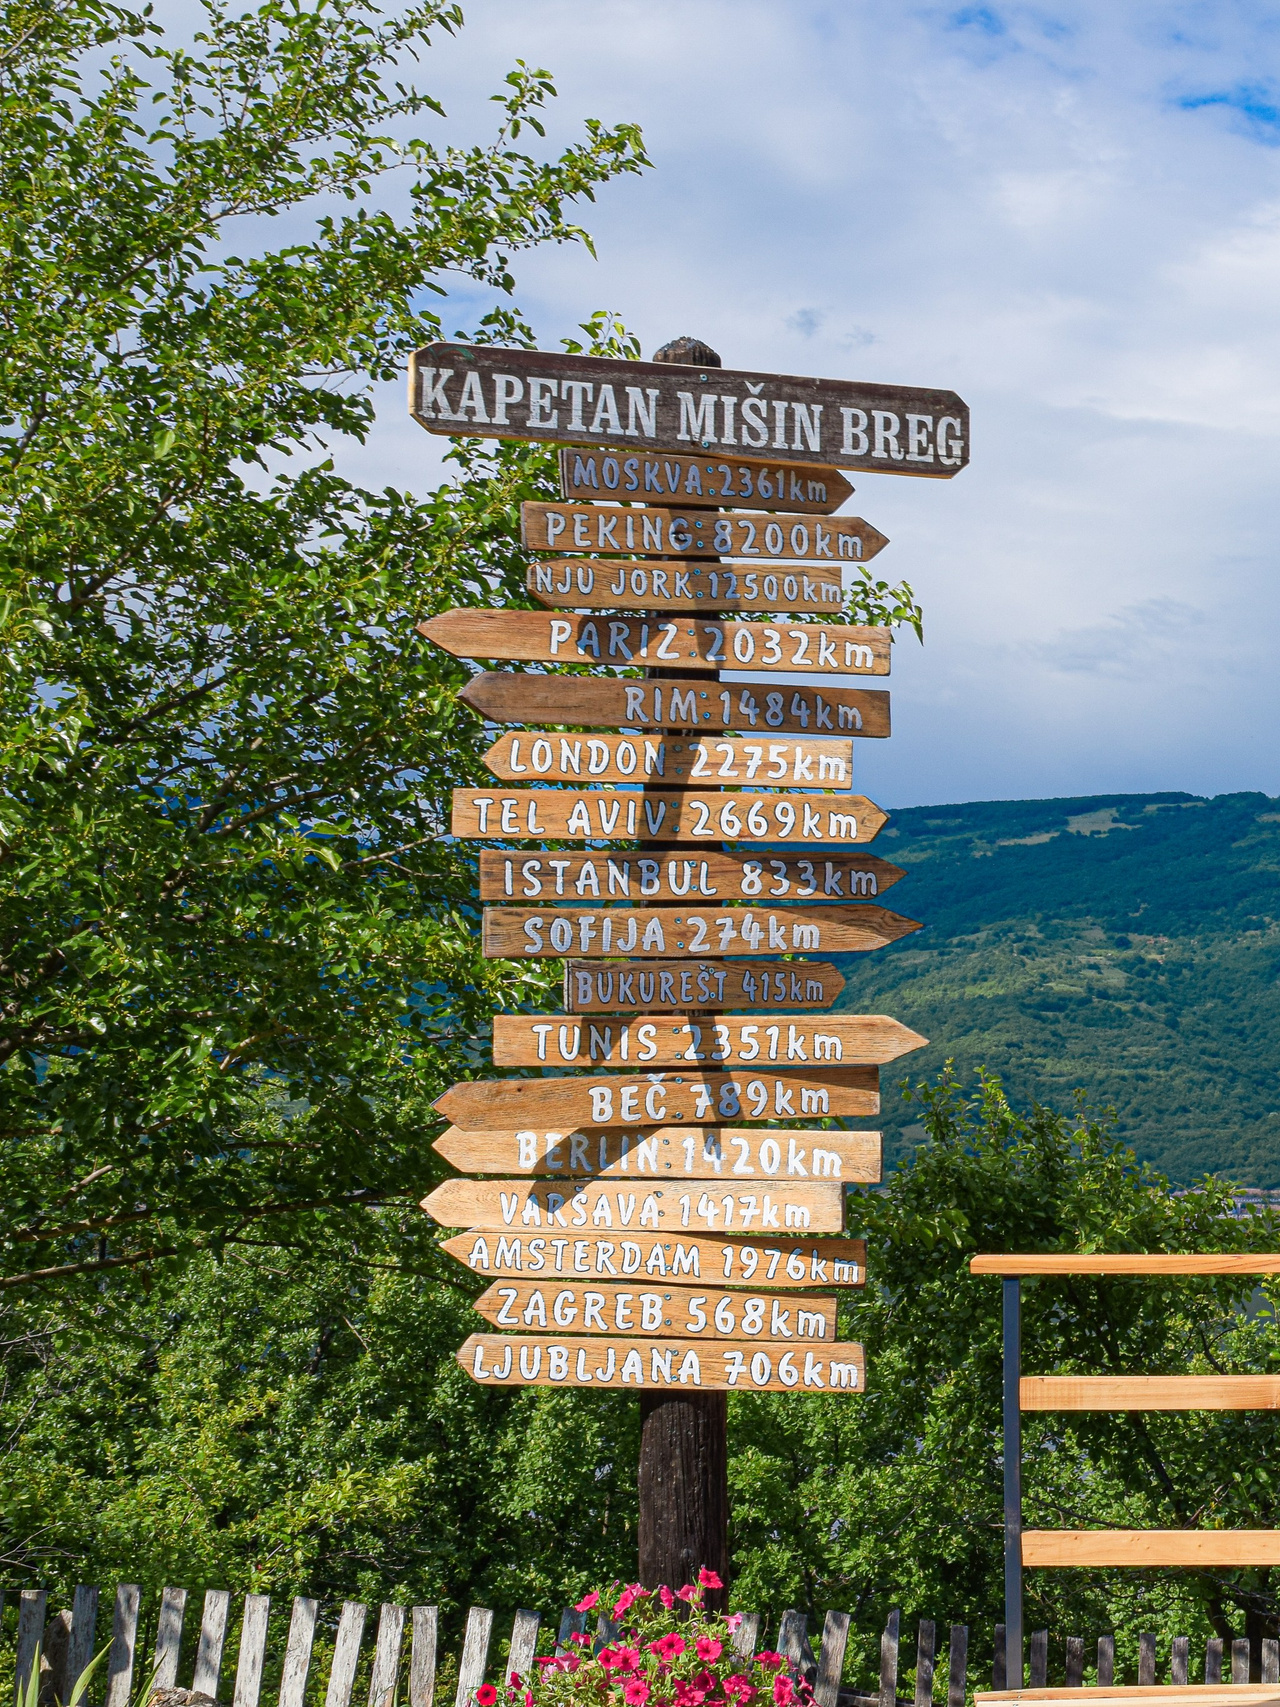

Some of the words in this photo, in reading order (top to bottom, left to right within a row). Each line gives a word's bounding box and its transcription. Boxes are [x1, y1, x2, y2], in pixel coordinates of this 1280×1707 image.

[418, 366, 660, 437] KAPETAN
[676, 381, 822, 453] MIŠIN
[840, 407, 965, 467] BREG
[572, 455, 700, 494] MOSKVA
[714, 464, 828, 503] 2361km
[546, 512, 693, 552] PEKING
[714, 518, 864, 559] 8200km
[534, 565, 594, 595] NJU
[611, 569, 694, 599] JORK
[708, 572, 843, 604] 12500km
[550, 620, 681, 661] PARIZ
[704, 626, 874, 669] 2032km
[625, 686, 699, 724] RIM
[719, 689, 864, 731] 1484km
[509, 738, 666, 777] LONDON
[690, 742, 847, 782] 2275km
[473, 797, 545, 834] TEL
[567, 799, 666, 837] AVIV
[688, 800, 858, 839] 2669km
[503, 858, 717, 898] ISTANBUL
[740, 860, 879, 896] 833km
[523, 915, 666, 954] SOFIJA
[685, 914, 821, 952] 274km
[575, 963, 726, 1005] BUKUREŠT
[742, 969, 824, 1003] 415km
[531, 1024, 658, 1061] TUNIS
[681, 1024, 844, 1062] 2351km
[587, 1072, 667, 1122] BEČ
[689, 1080, 830, 1119] 789km
[514, 1131, 659, 1171] BERLIN
[683, 1138, 843, 1178] 1420km
[499, 1186, 661, 1228] VARŠAVA
[679, 1193, 812, 1229] 1417km
[467, 1238, 701, 1277] AMSTERDAM
[721, 1245, 860, 1284] 1976km
[495, 1288, 664, 1330] ZAGREB
[688, 1296, 827, 1339] 568km
[472, 1344, 702, 1385] LJUBLJANA
[723, 1350, 860, 1389] 706km
